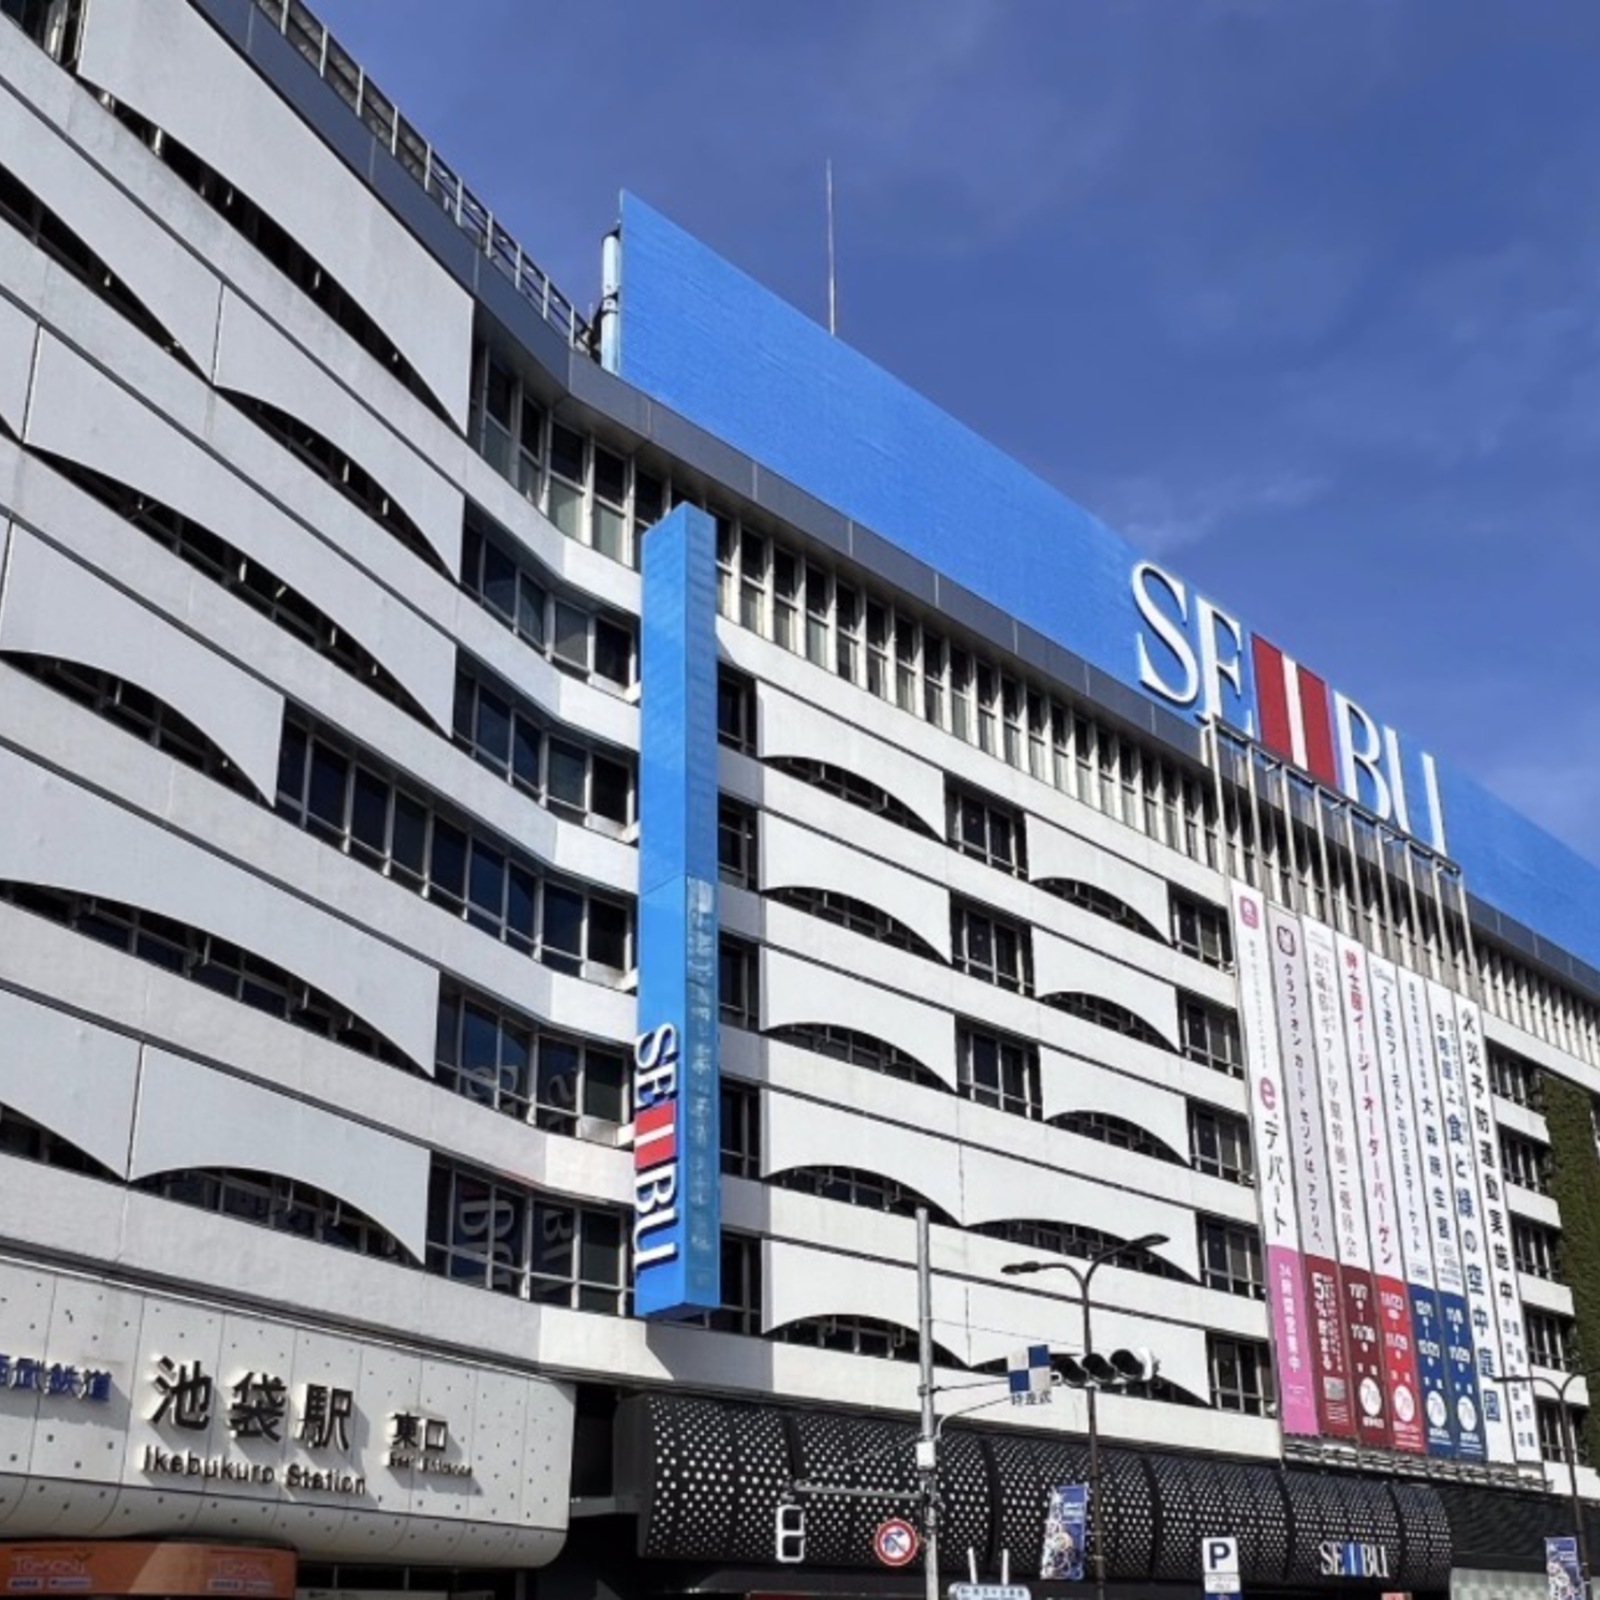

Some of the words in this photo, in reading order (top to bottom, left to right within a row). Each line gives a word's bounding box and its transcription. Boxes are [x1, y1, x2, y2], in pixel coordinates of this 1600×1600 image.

[1133, 562, 1446, 858] SEIBU
[633, 1023, 679, 1273] SEIBU
[151, 1356, 354, 1451] 池袋駅
[390, 1411, 448, 1451] 東口
[142, 1445, 275, 1484] Ikebukuro
[286, 1463, 366, 1494] Station
[1208, 1541, 1231, 1570] P
[1319, 1540, 1389, 1578] SEIBU
